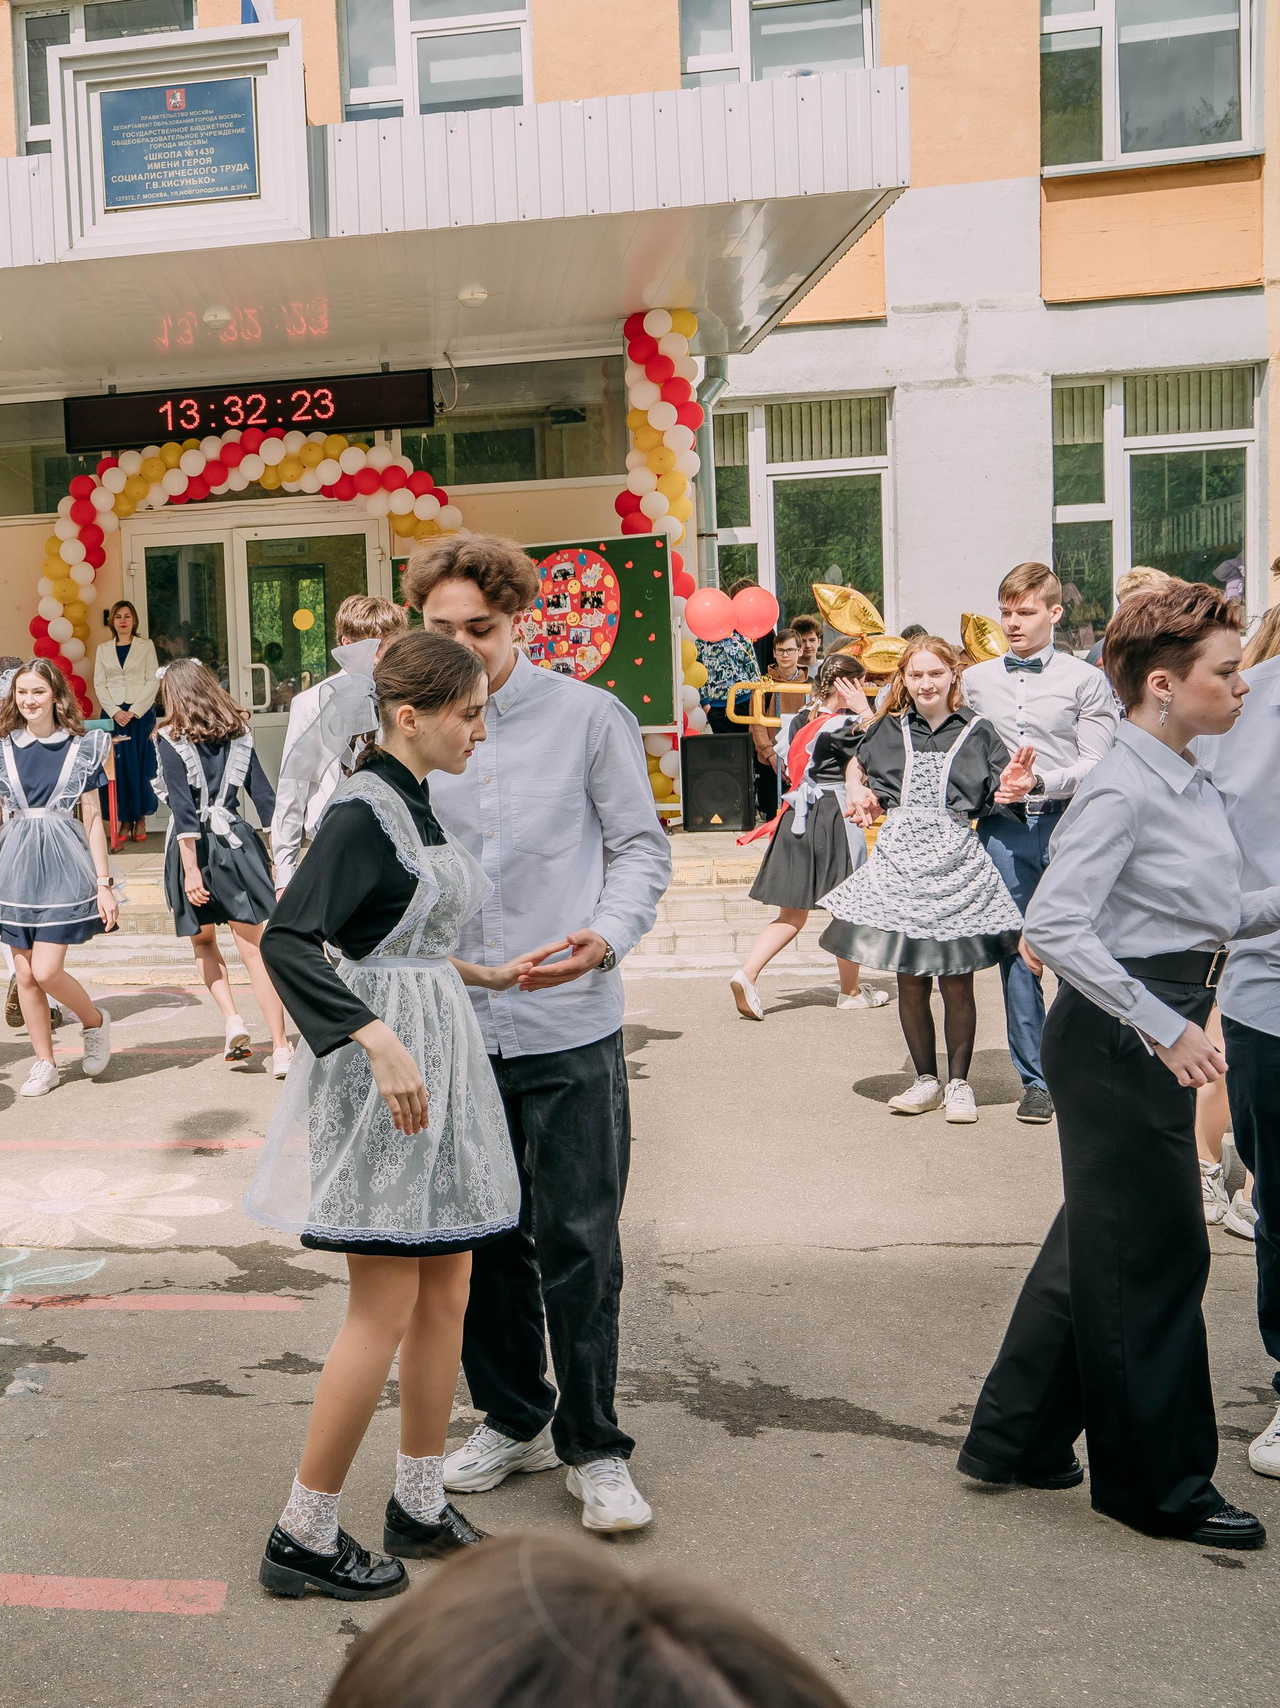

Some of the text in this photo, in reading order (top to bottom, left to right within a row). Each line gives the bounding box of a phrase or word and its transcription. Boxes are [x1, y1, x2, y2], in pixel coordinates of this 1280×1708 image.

[140, 112, 188, 121] ПРАВИТЕЛЬСТВО
[112, 122, 153, 131] ДЕПАРТАМЕНТ
[153, 119, 194, 127] ОБРАЗОВАНИЯ
[122, 122, 234, 138] ГОСУДАРСТВЕННОЕ БЮДЖЕТНОЕ
[111, 128, 246, 146] ОБЩЕОБРАЗОВАТЕЛЬНОЕ УЧРЕЖДЕНИЕ
[150, 139, 208, 150] ГОРОДА МОСКВЫ
[144, 150, 183, 161] «ШКОЛА
[147, 157, 212, 170] ИМЕНИ ГЕРОЯ
[111, 163, 250, 183] СОЦИАЛИСТИЧЕСКОГО ТРУДА
[158, 389, 335, 431] 13:32:23
